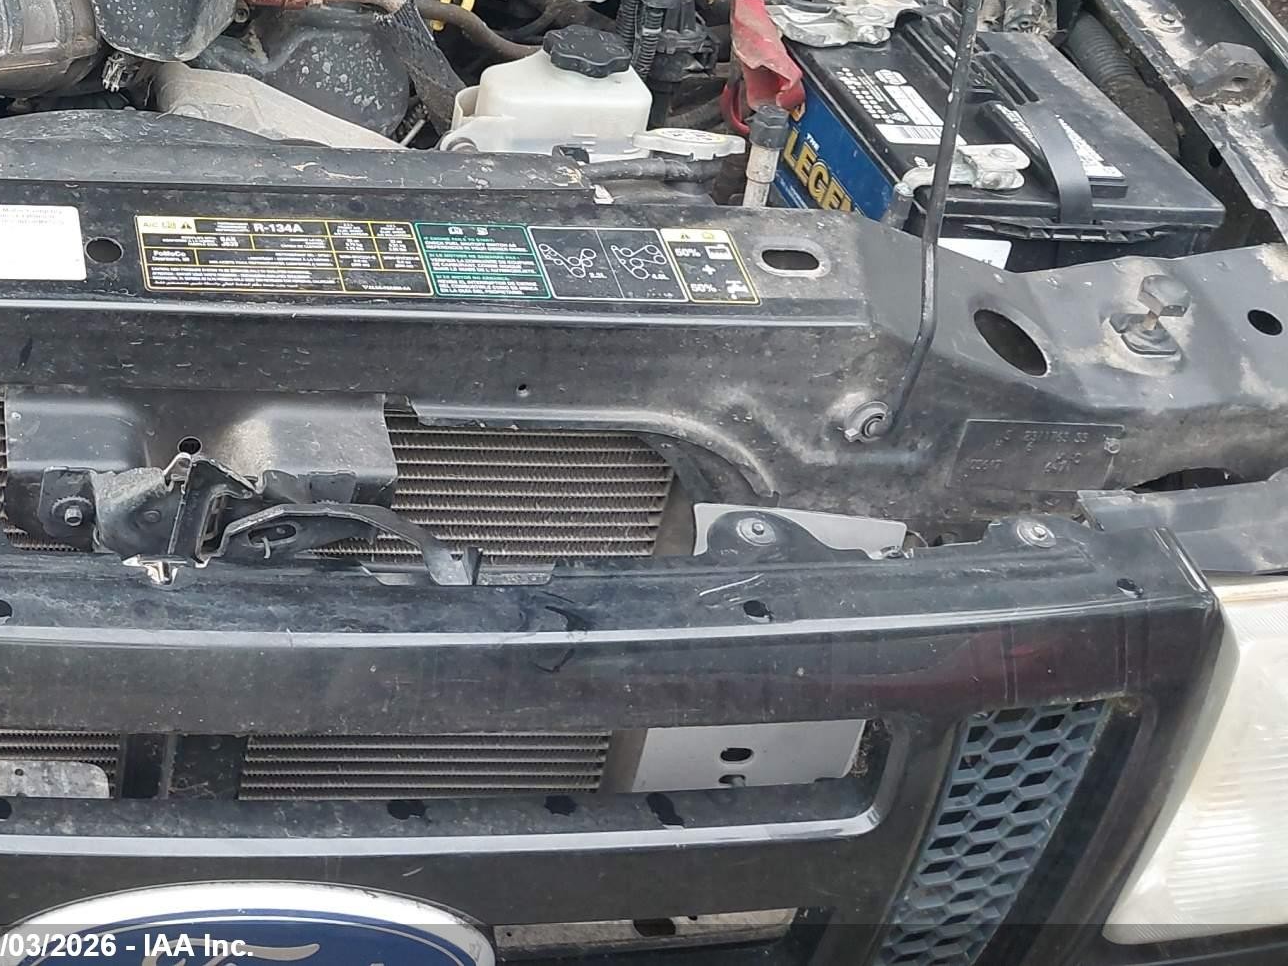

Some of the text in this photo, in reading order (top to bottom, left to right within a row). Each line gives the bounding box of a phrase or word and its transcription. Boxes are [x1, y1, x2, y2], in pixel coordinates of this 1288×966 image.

[253, 222, 304, 233] R-134A
[674, 247, 701, 258] 50%
[690, 283, 717, 293] 50%
